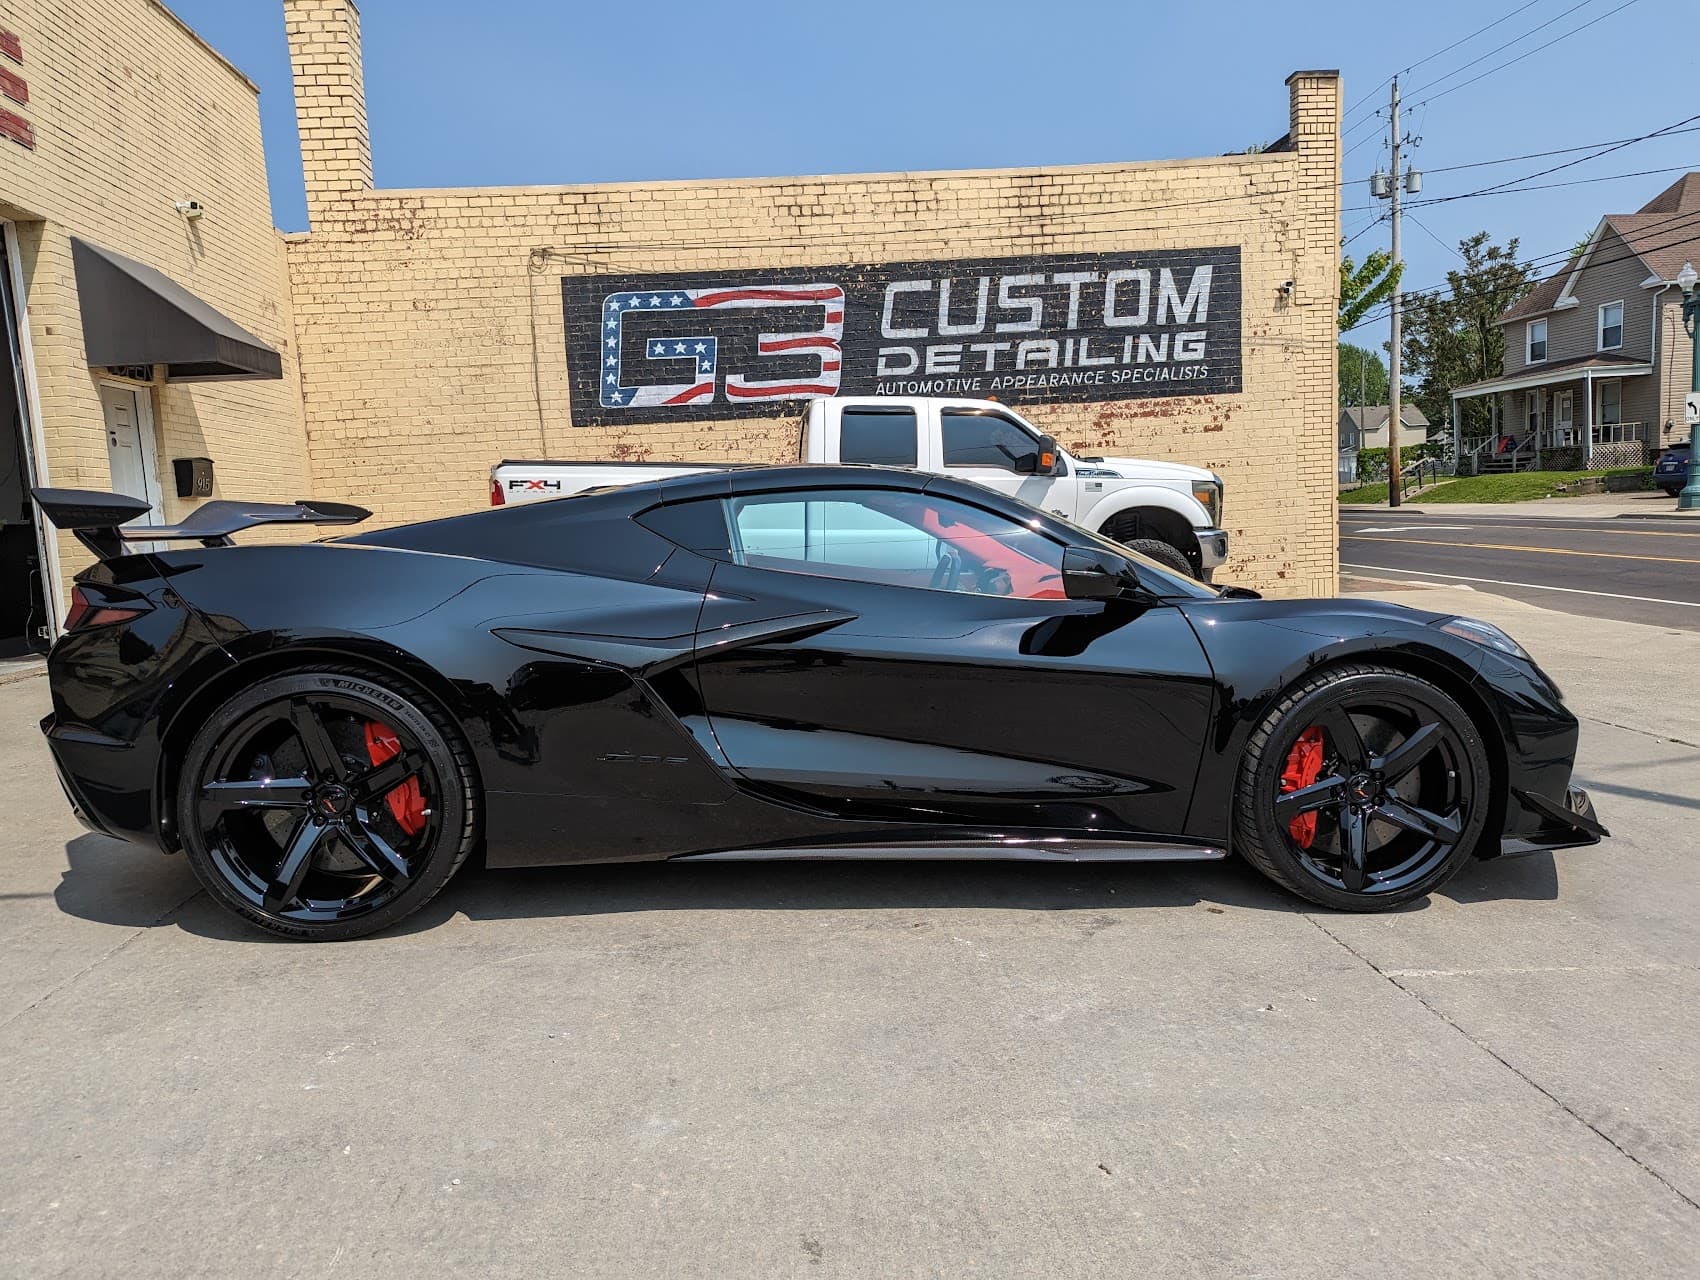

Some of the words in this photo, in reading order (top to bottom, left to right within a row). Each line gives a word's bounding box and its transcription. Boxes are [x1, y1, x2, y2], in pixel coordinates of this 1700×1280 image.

[880, 265, 1213, 339] CUSTOM
[599, 283, 845, 409] G3
[876, 330, 1208, 376] DETAILING
[875, 378, 982, 396] AUTOMOTIVE
[990, 370, 1105, 390] APPEARANCE
[1111, 365, 1209, 383] SPECIALISTS
[197, 477, 210, 491] 915
[509, 480, 561, 490] FX4
[337, 680, 405, 710] MICHELIN
